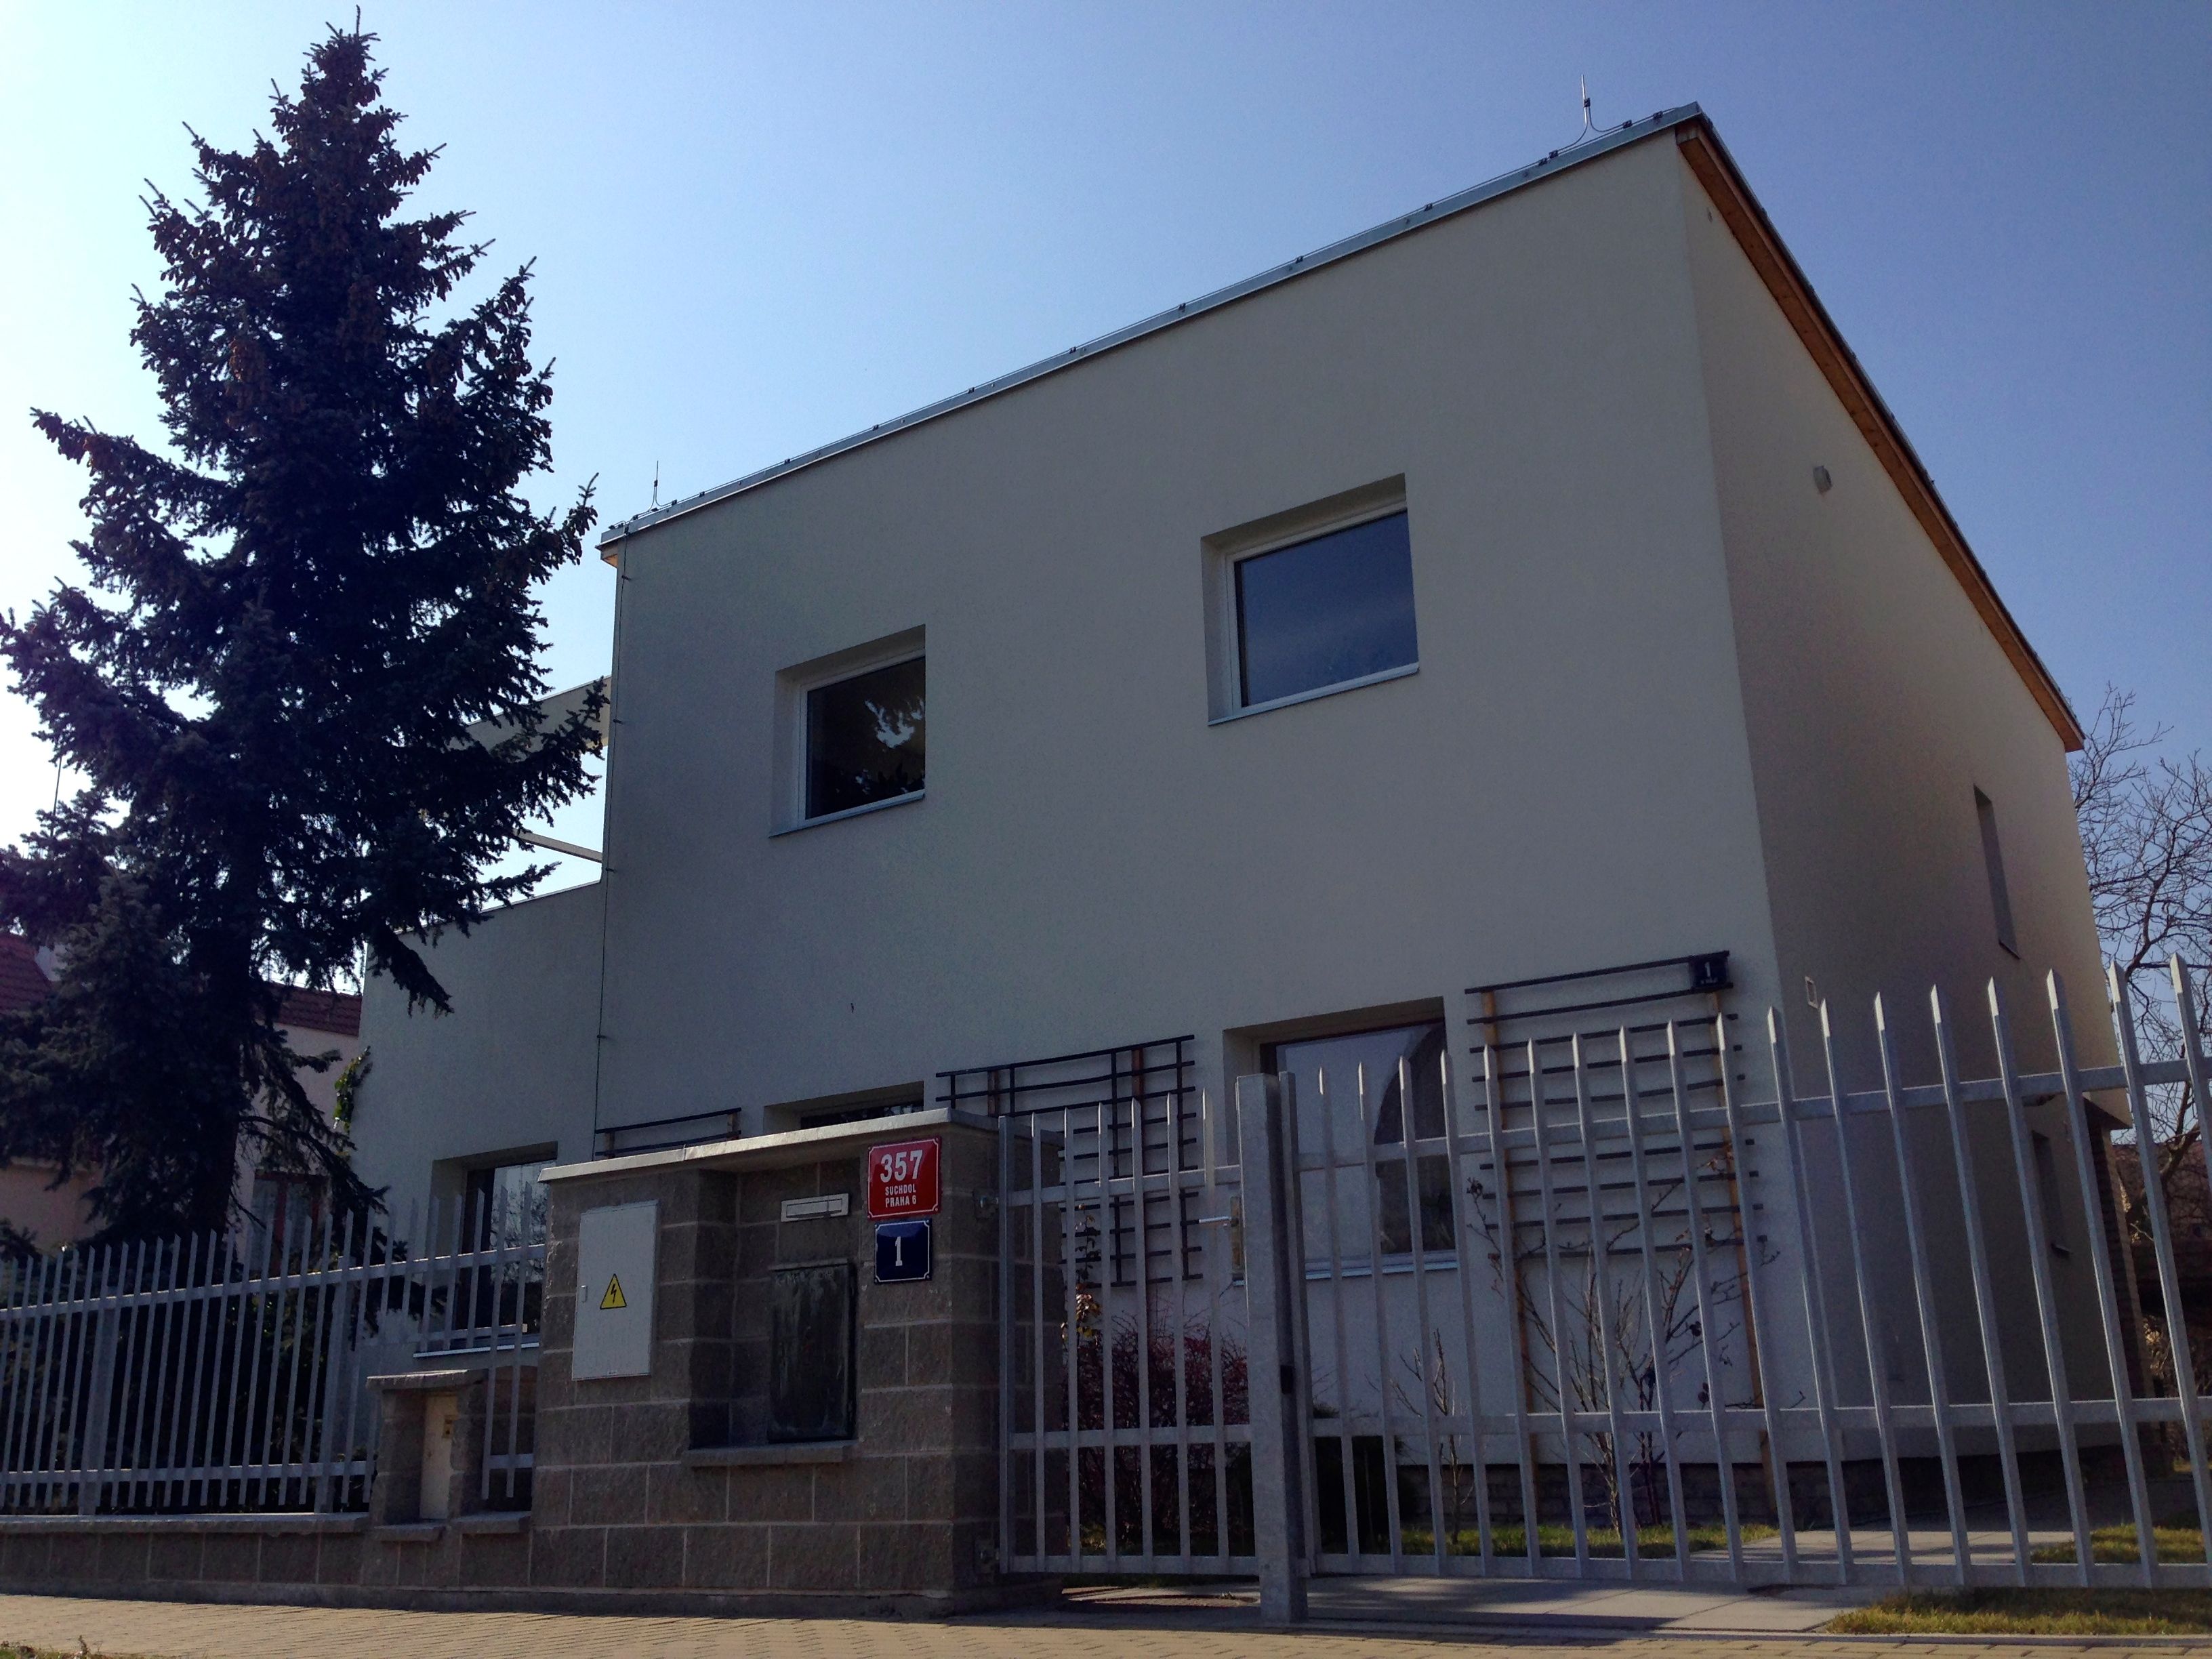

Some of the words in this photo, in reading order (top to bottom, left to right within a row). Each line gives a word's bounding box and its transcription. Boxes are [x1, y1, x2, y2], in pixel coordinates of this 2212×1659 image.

[880, 1149, 923, 1183] 357
[885, 1184, 916, 1195] SUCHDOL
[885, 1196, 909, 1208] PRAHA
[912, 1195, 917, 1205] 6
[895, 1235, 903, 1267] 1
